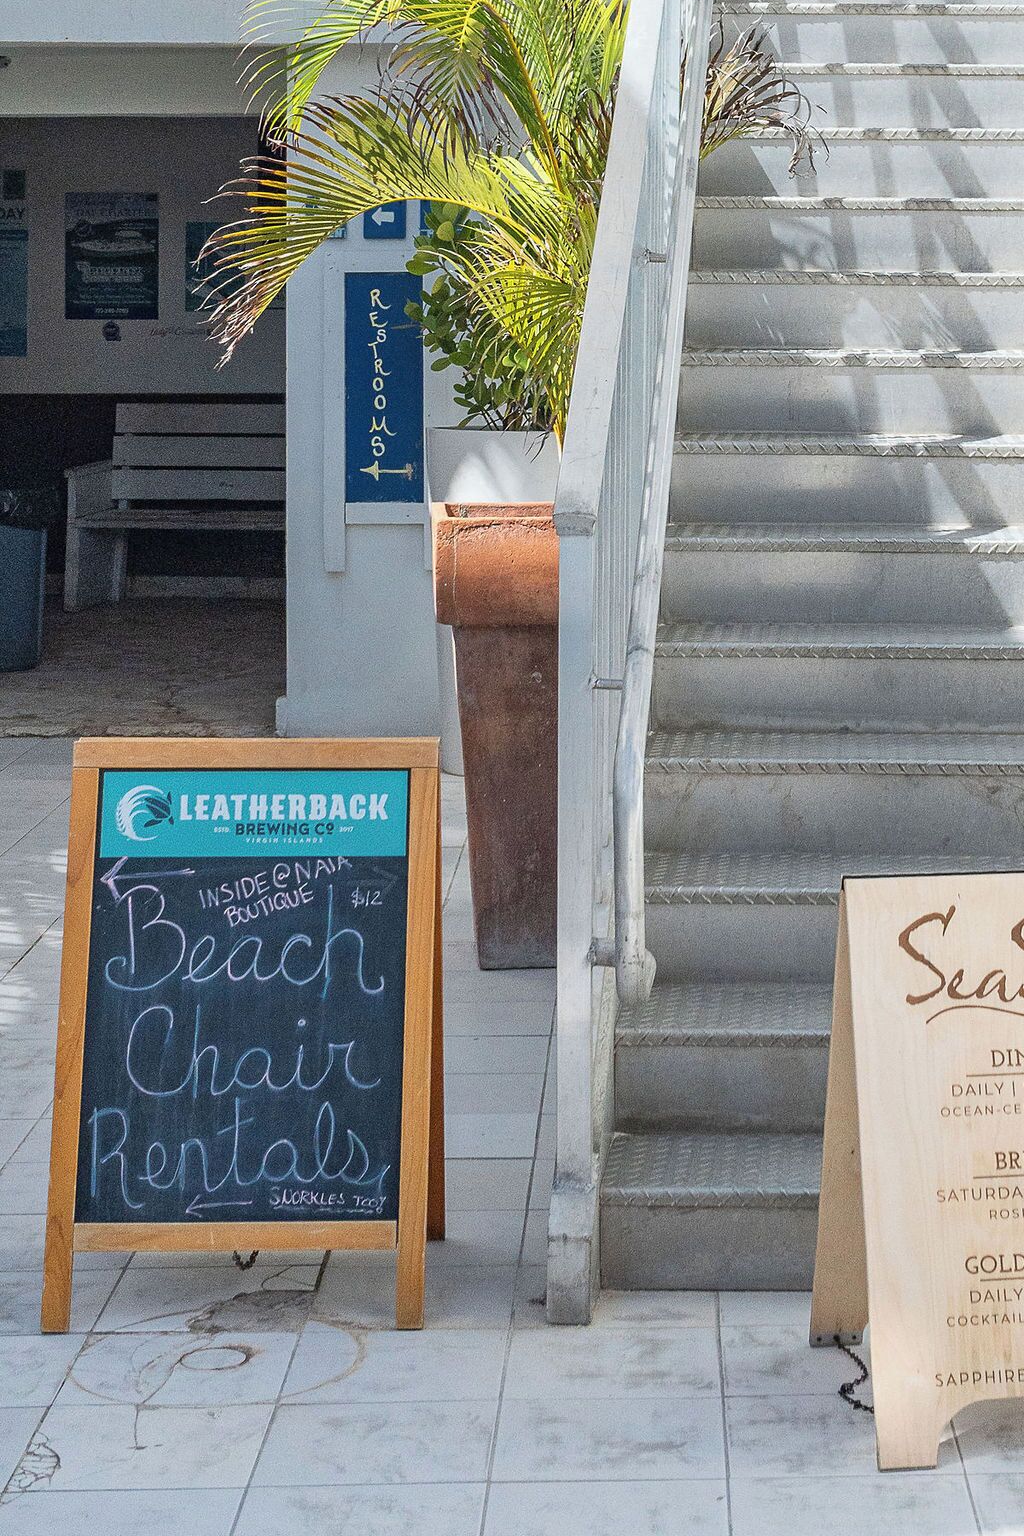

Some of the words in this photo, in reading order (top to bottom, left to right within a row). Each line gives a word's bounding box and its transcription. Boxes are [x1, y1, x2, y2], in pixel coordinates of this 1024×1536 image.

[367, 288, 398, 457] RESTROOMS
[179, 793, 389, 821] LEATHERBACK
[235, 822, 310, 835] BREWING
[199, 871, 271, 910] INSIDE
[223, 882, 314, 928] BOUTIQUE
[351, 886, 383, 909] $12
[104, 884, 385, 999] Beach
[125, 1005, 382, 1100] Chair
[950, 1082, 1005, 1097] DAILY
[969, 1287, 1024, 1305] DAILY
